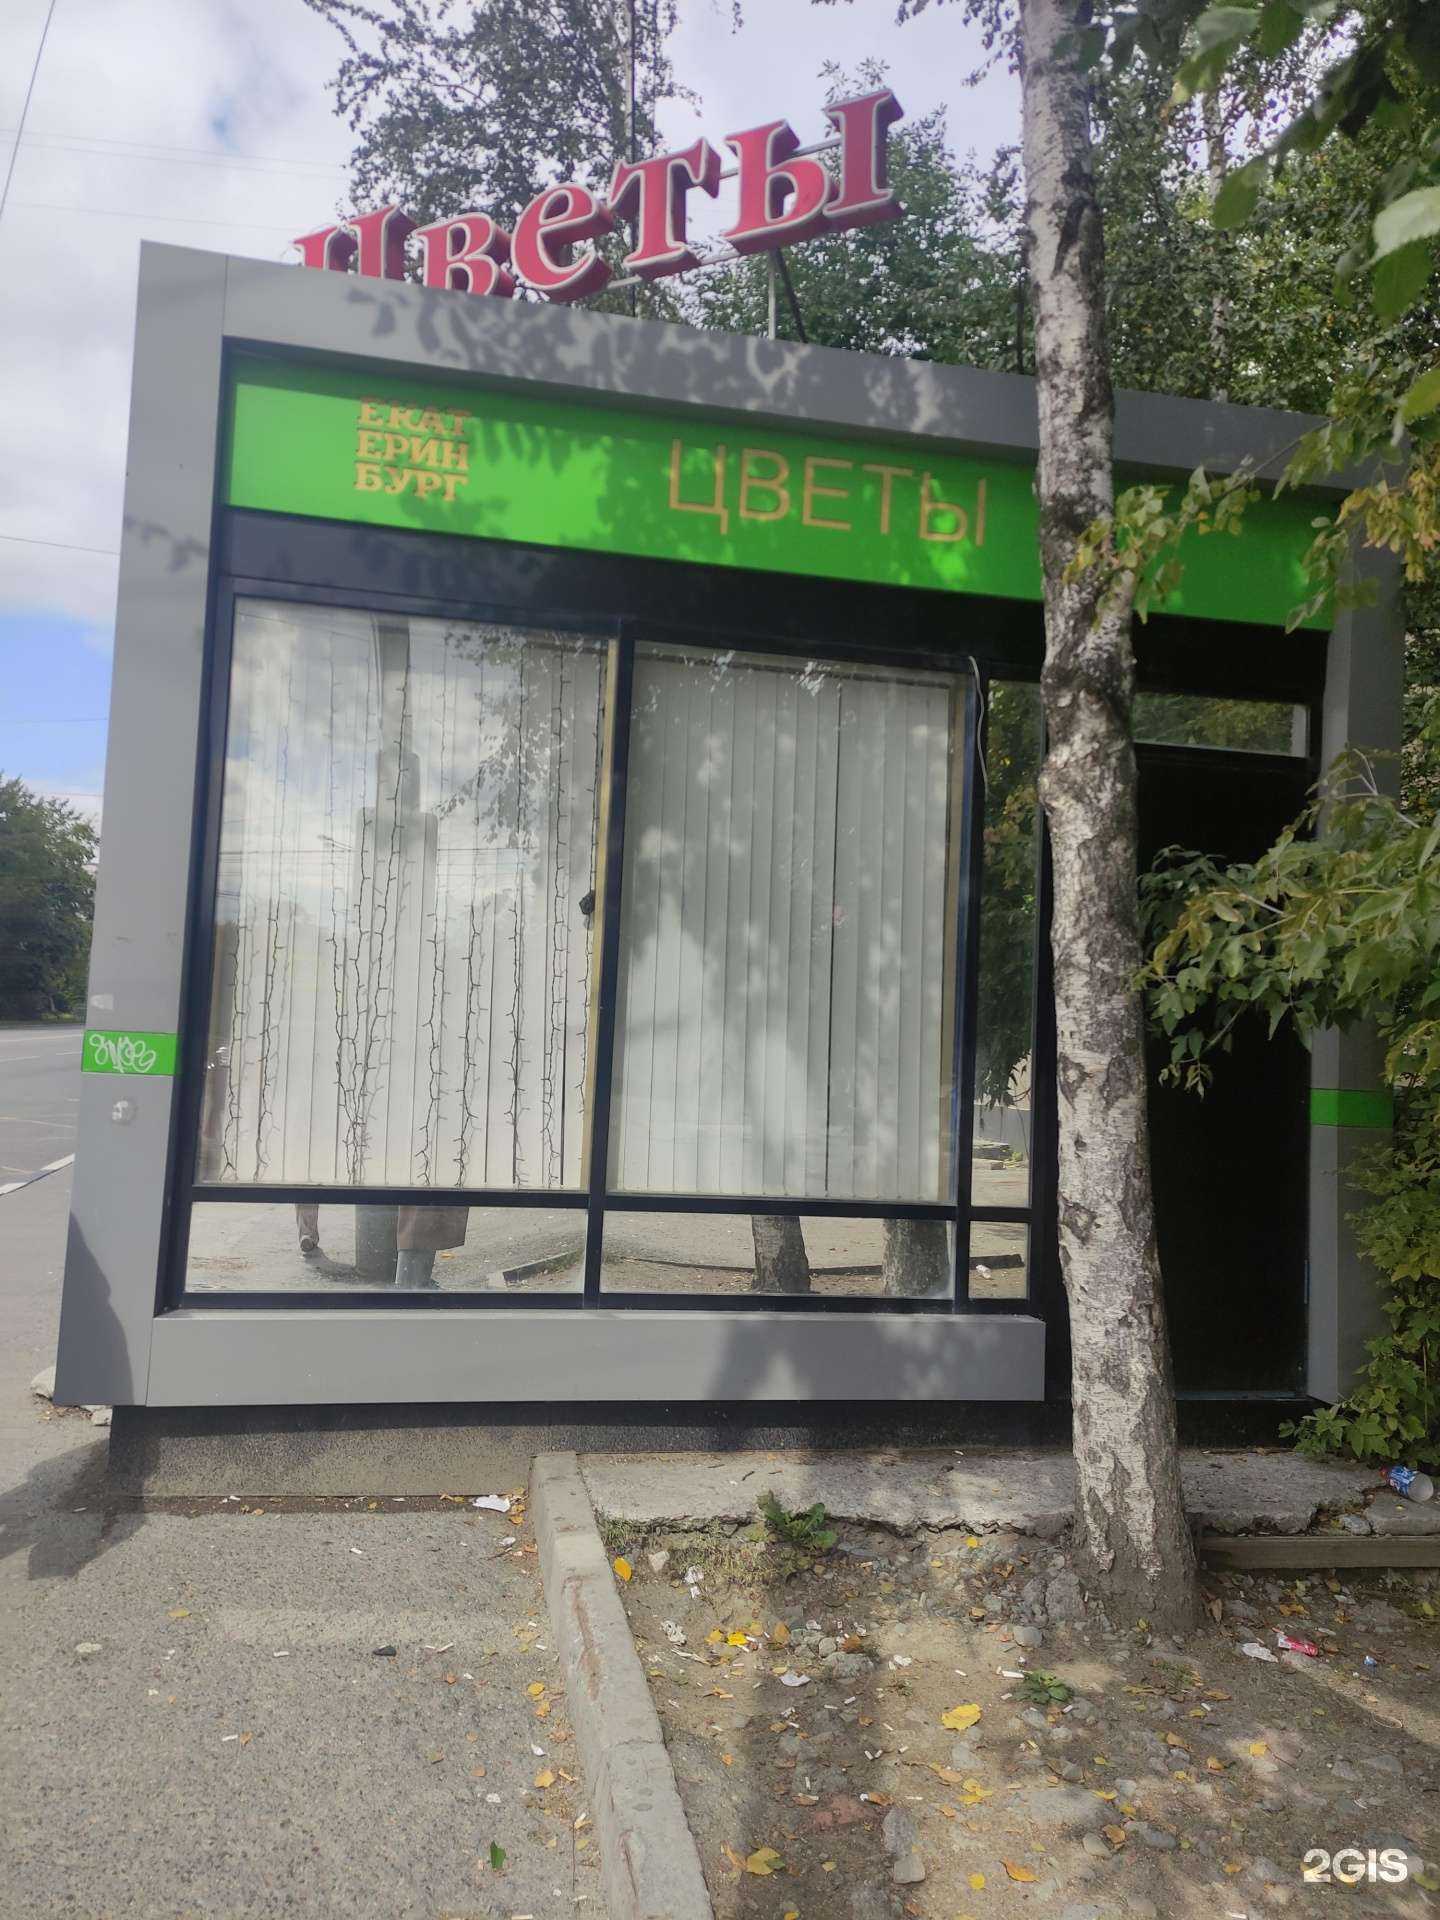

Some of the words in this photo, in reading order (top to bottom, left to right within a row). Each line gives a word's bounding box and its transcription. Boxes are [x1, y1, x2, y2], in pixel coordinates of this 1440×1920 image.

[357, 397, 471, 436] ЕКАТ
[356, 428, 470, 470] ЕРИН
[354, 461, 469, 501] БУРГ
[668, 438, 987, 547] ЦВЕТЫ
